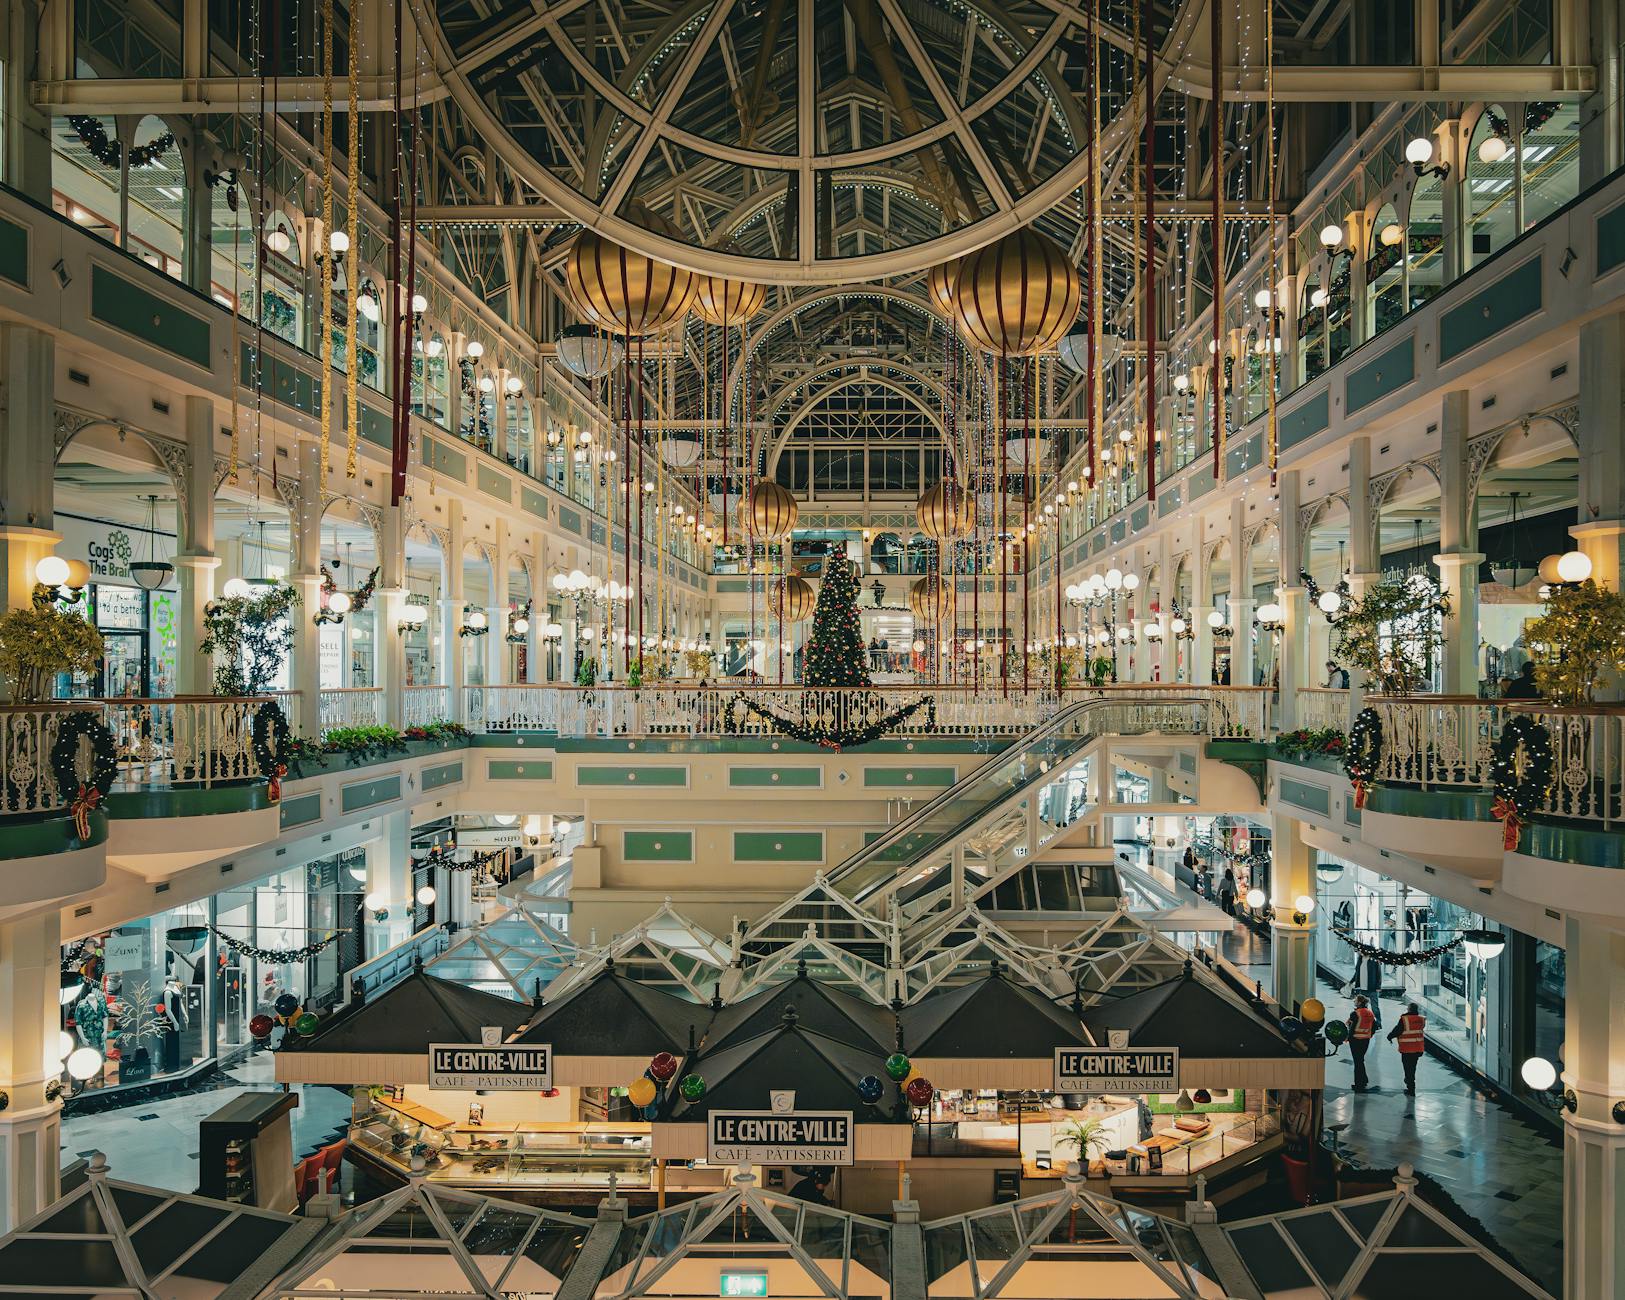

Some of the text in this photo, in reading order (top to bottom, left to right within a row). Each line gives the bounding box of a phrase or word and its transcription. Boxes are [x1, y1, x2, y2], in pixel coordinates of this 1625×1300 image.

[88, 541, 114, 563] Cogs
[89, 560, 107, 576] The
[436, 1051, 545, 1071] LE CENTRE-VILLE
[1062, 1055, 1172, 1074] LE CENTRE-VILLE
[717, 1119, 846, 1142] LE CENTRE-VILLE
[766, 1146, 846, 1161] PÂTISSERIE
